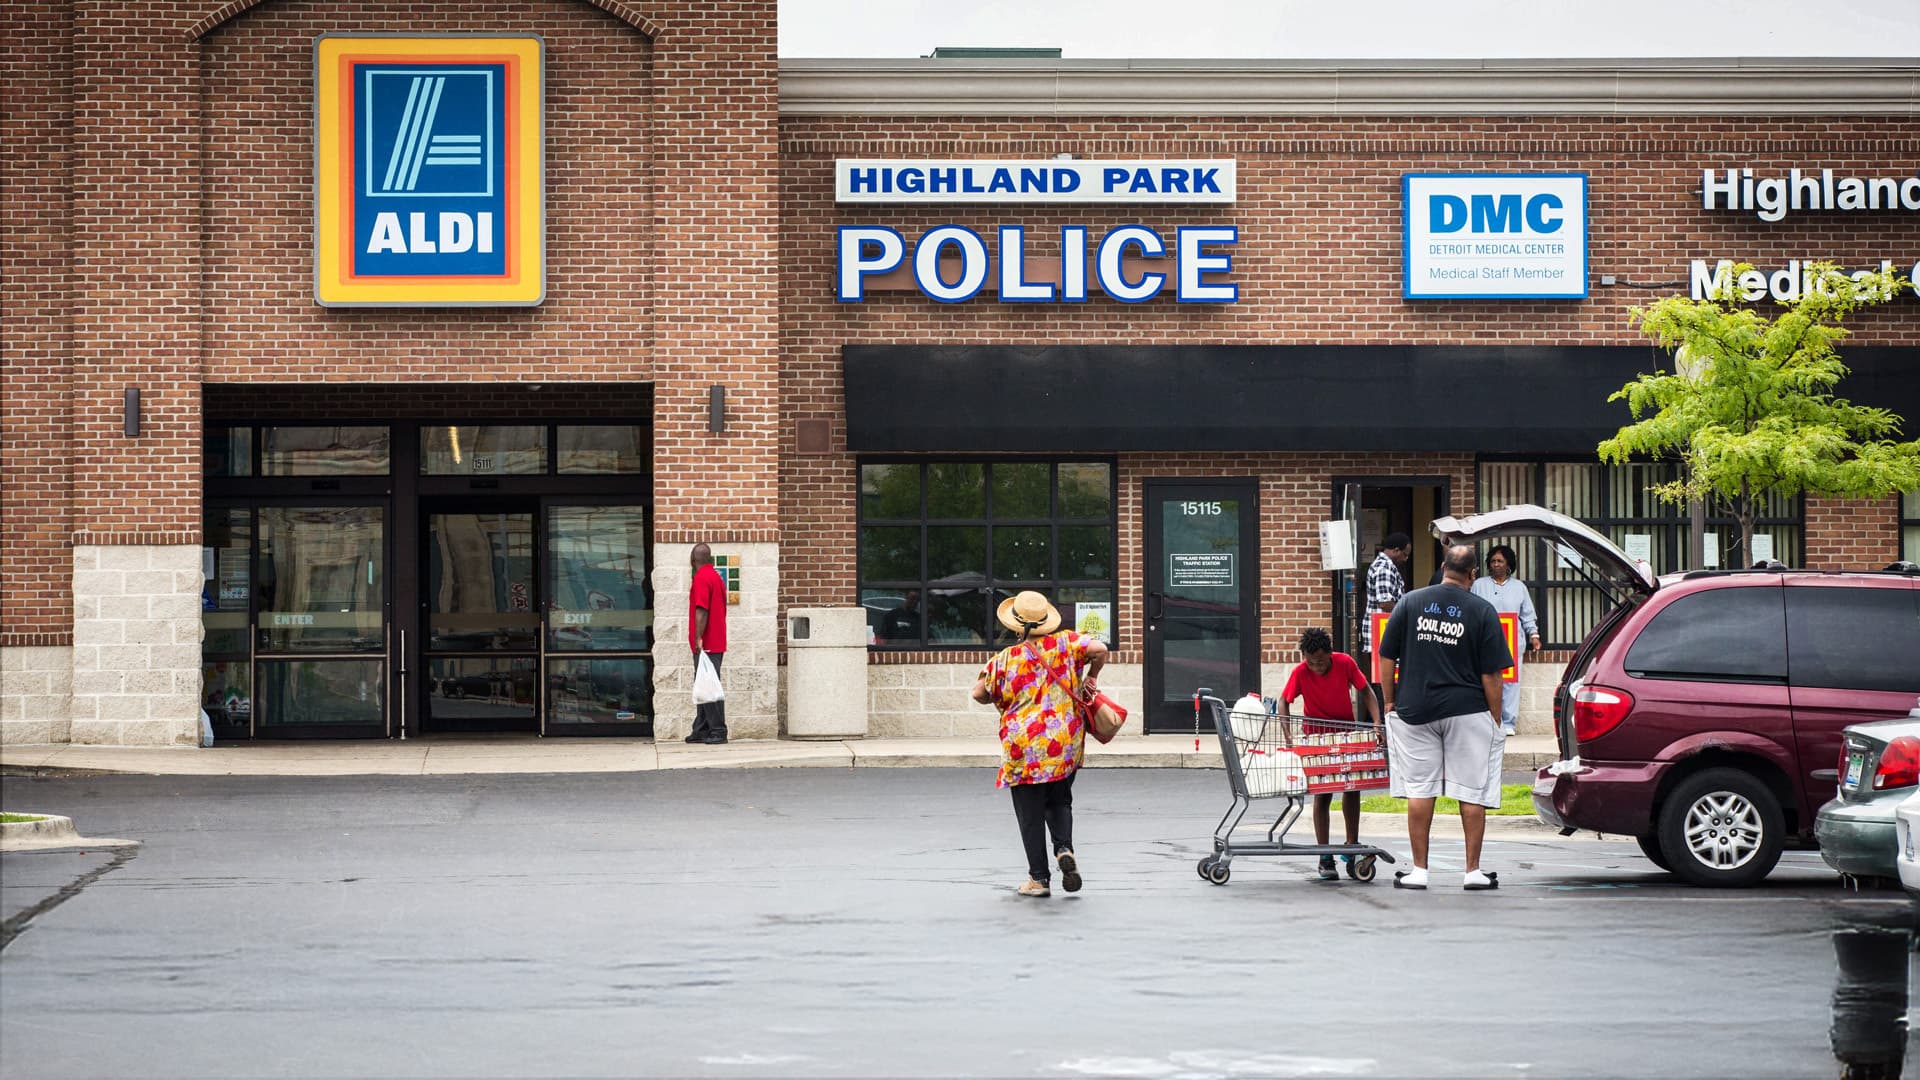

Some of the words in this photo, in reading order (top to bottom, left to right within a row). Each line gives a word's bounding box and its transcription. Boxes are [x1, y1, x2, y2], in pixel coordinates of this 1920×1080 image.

[850, 168, 1081, 193] HIGHLAND
[1103, 168, 1221, 193] PARK
[1429, 193, 1564, 234] DMC
[366, 212, 493, 254] ALDI
[1429, 244, 1472, 255] DETROIT
[1476, 244, 1522, 255] MEDICAL
[1524, 244, 1564, 255] CENTER
[837, 223, 1238, 303] POLICE
[1429, 267, 1478, 279] Medical
[1482, 267, 1510, 279] Staff
[1513, 267, 1564, 279] Member
[1180, 501, 1222, 515] 15115
[274, 614, 314, 625] ENTER
[564, 613, 592, 624] EXIT
[1416, 615, 1438, 632] SOUL
[1439, 621, 1464, 638] FOOD
